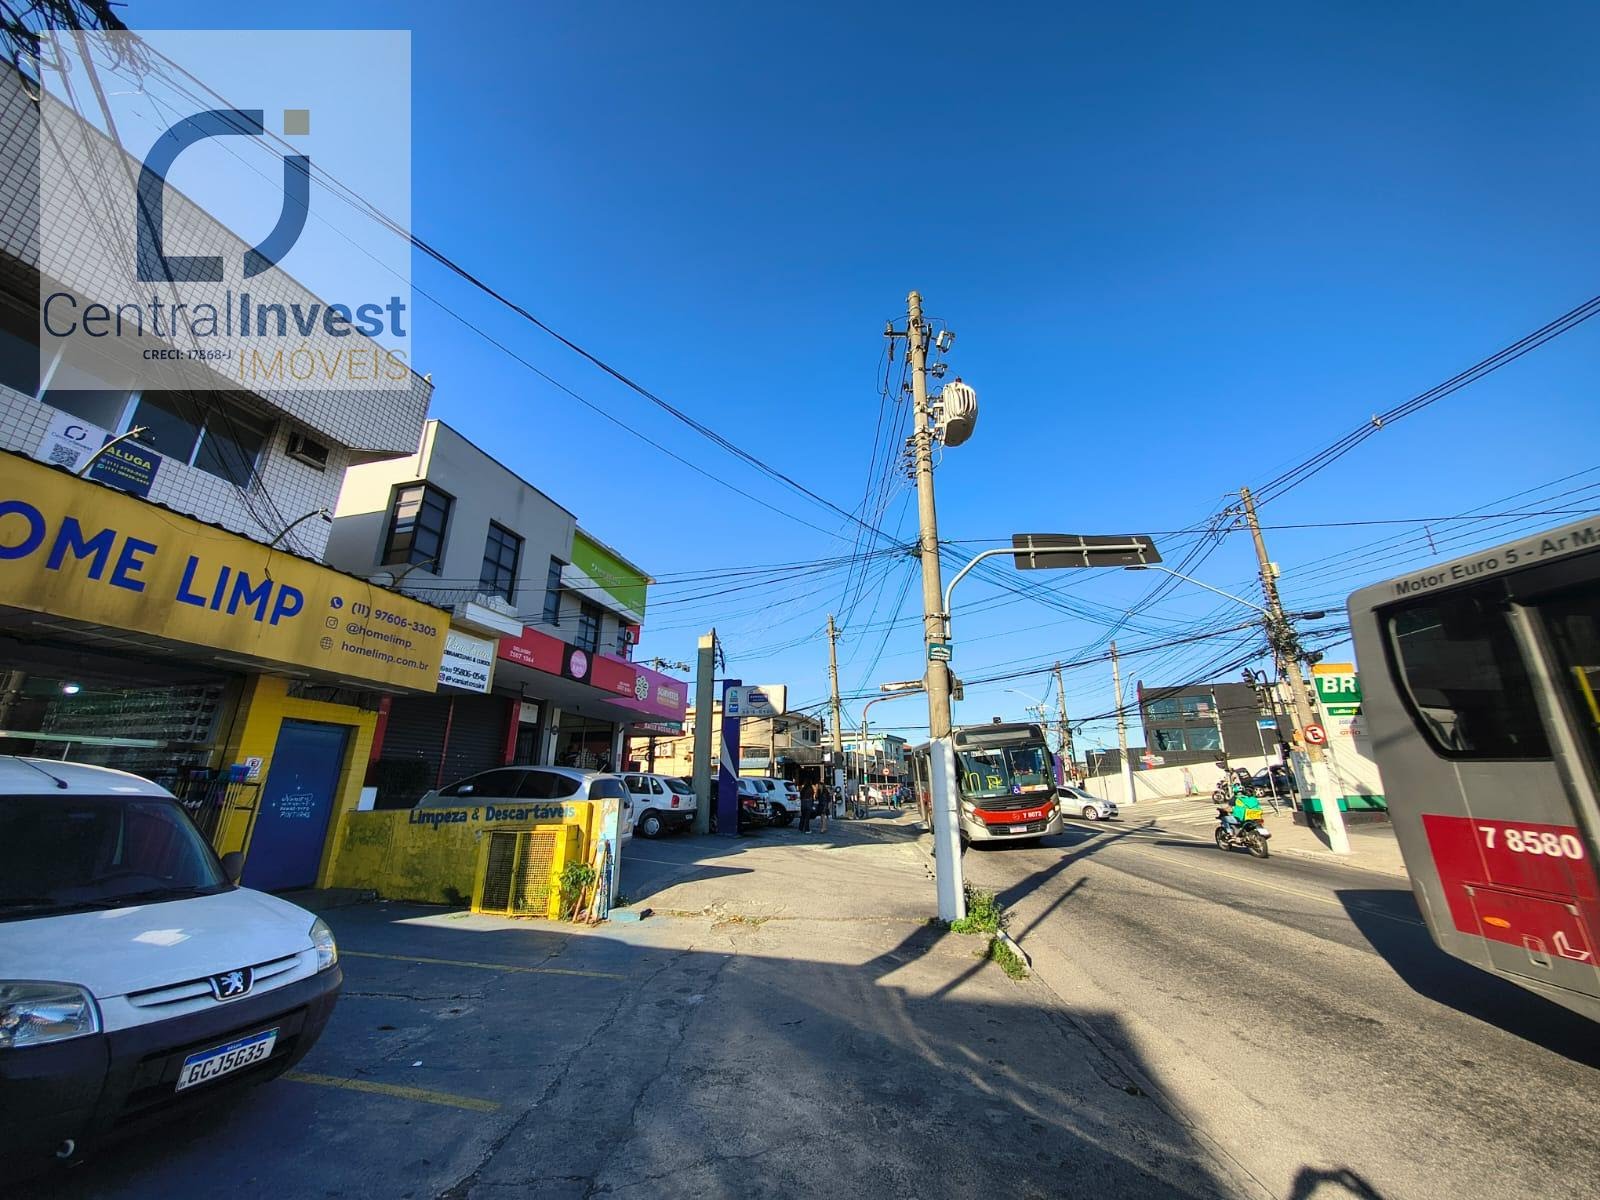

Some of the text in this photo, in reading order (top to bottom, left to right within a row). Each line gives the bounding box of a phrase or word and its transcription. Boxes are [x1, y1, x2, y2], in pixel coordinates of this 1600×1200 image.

[106, 446, 152, 470] ALUGA
[1396, 571, 1446, 596] Motor
[1451, 557, 1499, 580] Euro
[1505, 549, 1519, 564] 5
[1540, 537, 1568, 556] Ar
[176, 555, 304, 626] LIMP
[351, 602, 437, 637] (11) 97606-3303
[341, 641, 429, 671] homelimp.com.br
[1322, 676, 1356, 693] BR
[408, 804, 575, 830] Limpeza & Descartáveis
[1478, 826, 1584, 860] 7 8580
[188, 1041, 267, 1083] GCJ5G35
